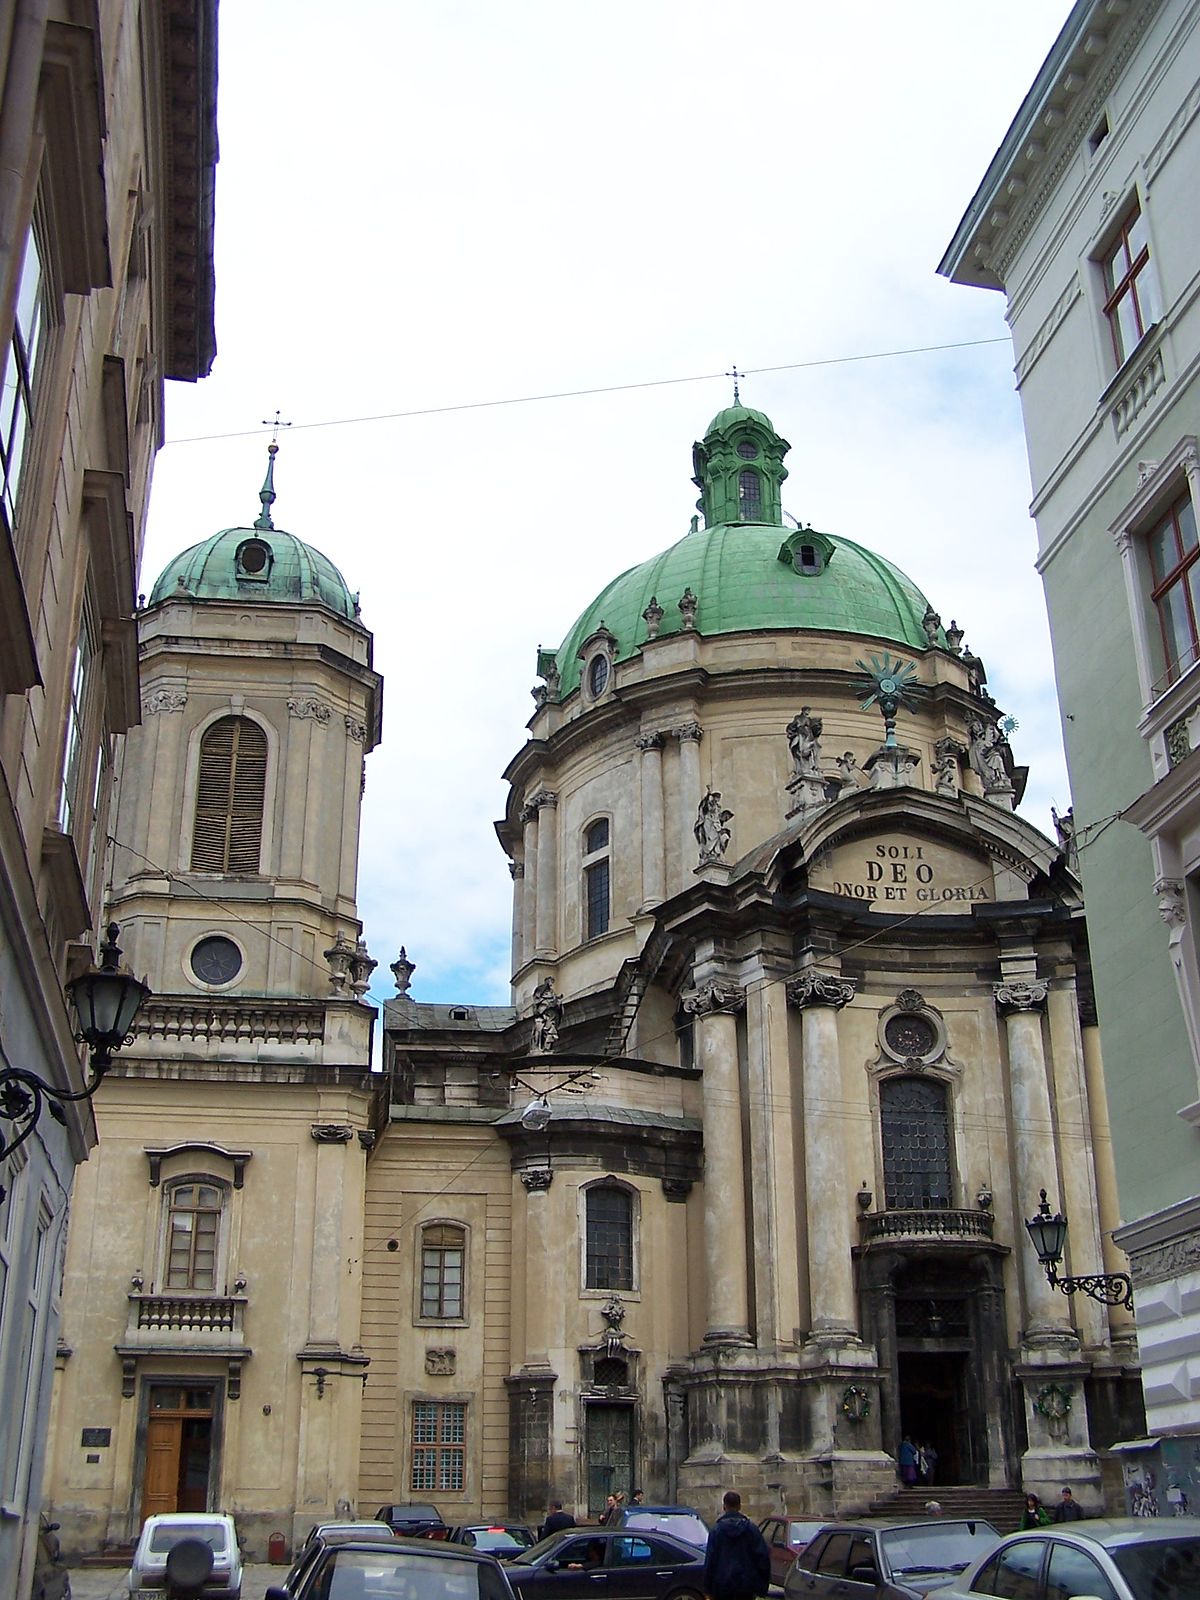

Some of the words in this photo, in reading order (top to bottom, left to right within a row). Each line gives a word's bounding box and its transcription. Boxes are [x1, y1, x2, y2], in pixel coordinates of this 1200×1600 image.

[876, 845, 923, 859] SOLI
[866, 861, 933, 884] DEO
[884, 886, 907, 900] ET
[917, 887, 990, 901] GLORIA
